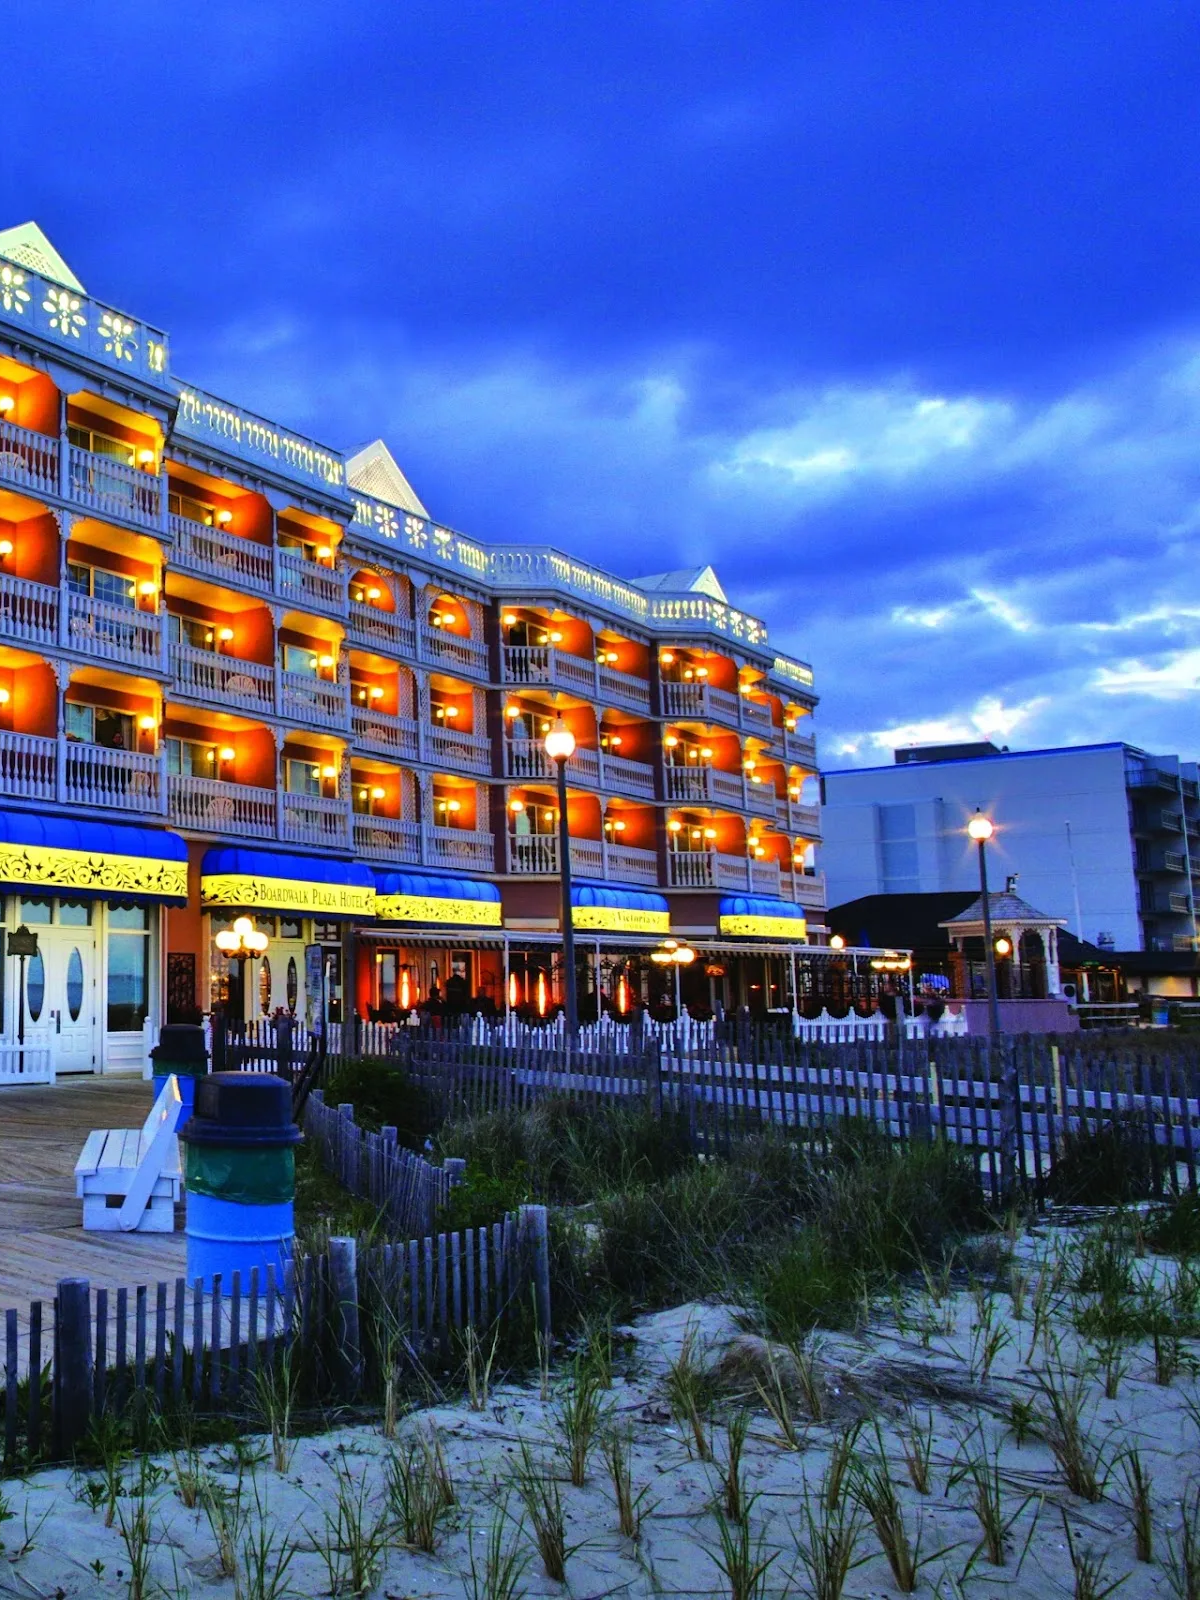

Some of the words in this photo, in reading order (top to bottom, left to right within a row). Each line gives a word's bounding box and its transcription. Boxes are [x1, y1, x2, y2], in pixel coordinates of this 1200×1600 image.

[260, 884, 309, 903] BOARDWALK
[312, 889, 337, 906] PLAZA
[340, 891, 364, 908] HOTEL
[617, 911, 656, 923] Victorias
